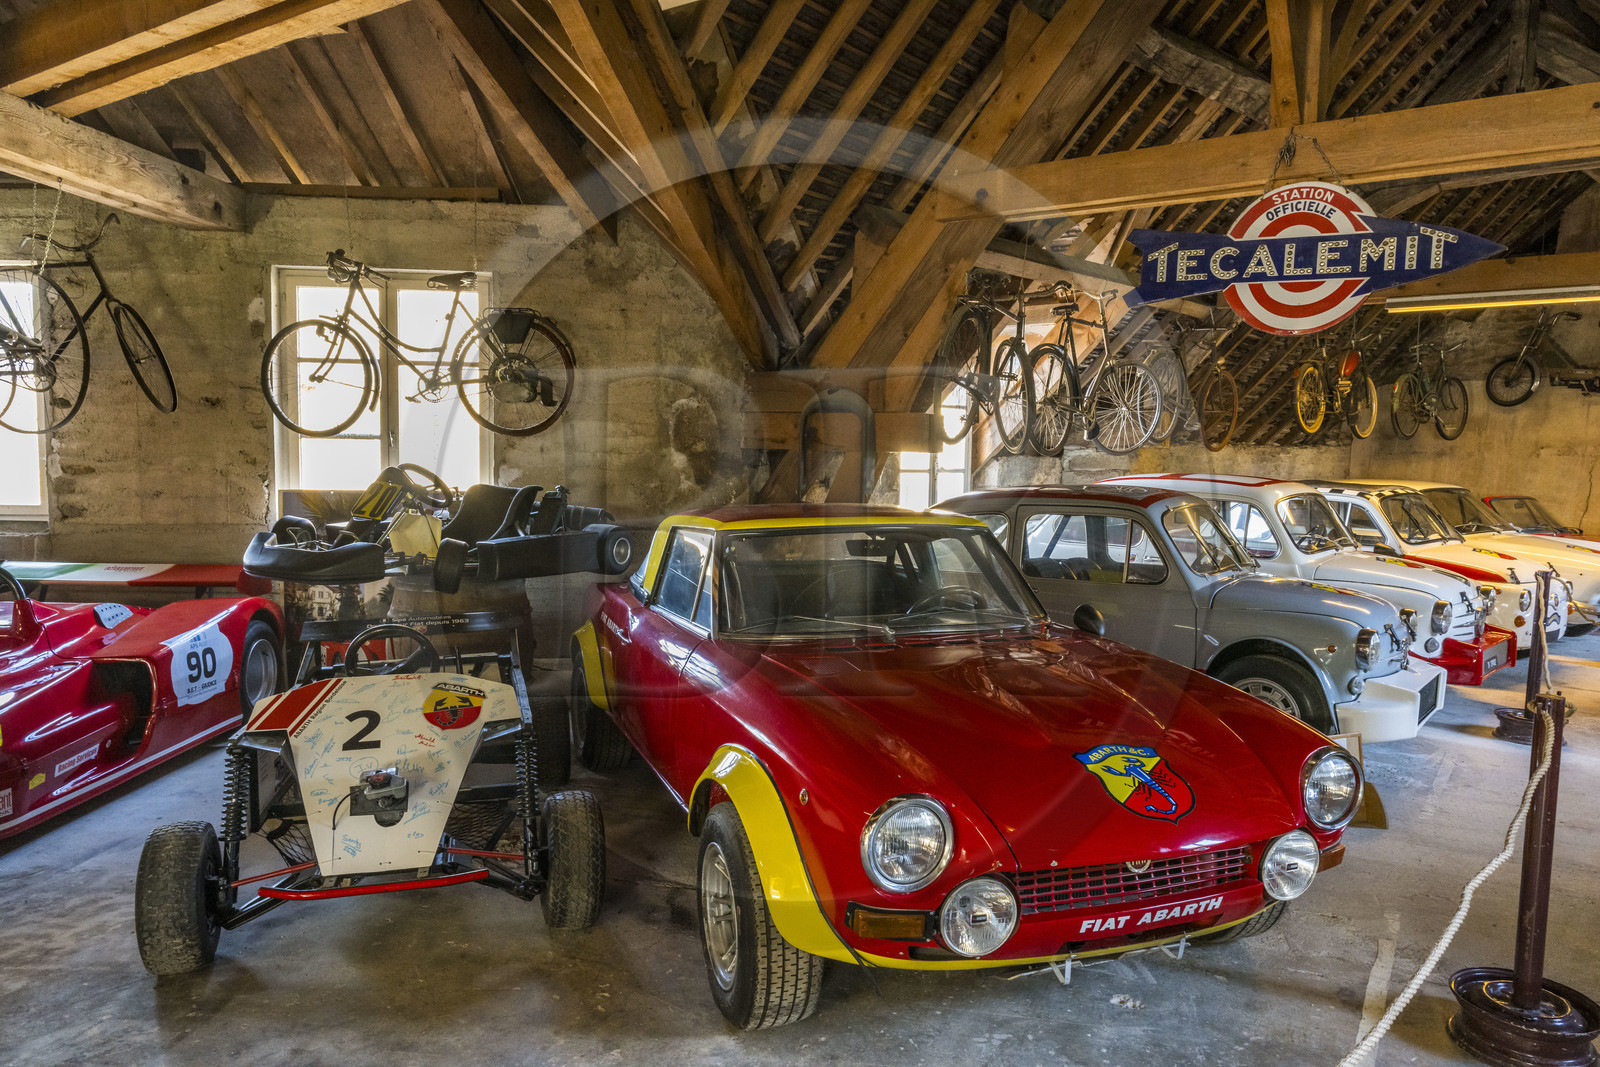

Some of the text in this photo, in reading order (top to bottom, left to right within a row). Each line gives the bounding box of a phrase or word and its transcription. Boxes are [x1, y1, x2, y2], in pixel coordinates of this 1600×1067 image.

[1272, 188, 1335, 204] STATION
[1266, 201, 1337, 221] OFFICIELLE
[1147, 226, 1459, 283] TECALEMIT
[353, 482, 398, 518] 20
[186, 647, 217, 684] 90
[436, 683, 484, 696] ABARTH
[293, 719, 313, 739] ABARTH
[342, 710, 381, 752] 2
[1088, 746, 1128, 762] ABARTH
[1079, 896, 1224, 934] FIAT ABARTH
